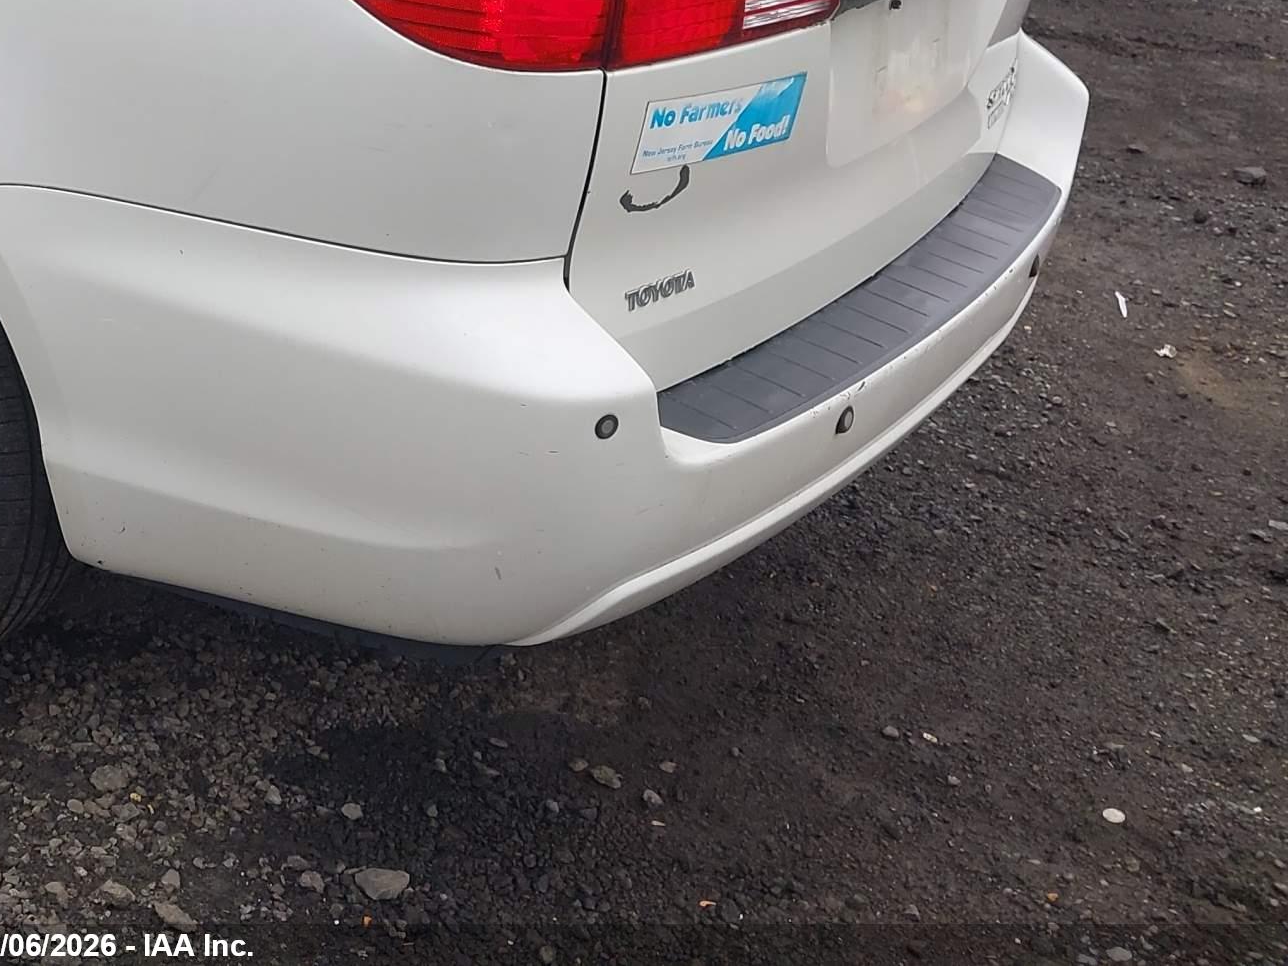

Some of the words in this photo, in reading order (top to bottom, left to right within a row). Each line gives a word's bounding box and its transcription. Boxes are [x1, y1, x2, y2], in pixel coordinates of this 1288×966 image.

[649, 107, 676, 130] No
[723, 126, 747, 151] No
[747, 114, 791, 145] Food!
[624, 269, 696, 312] TOYOTA
